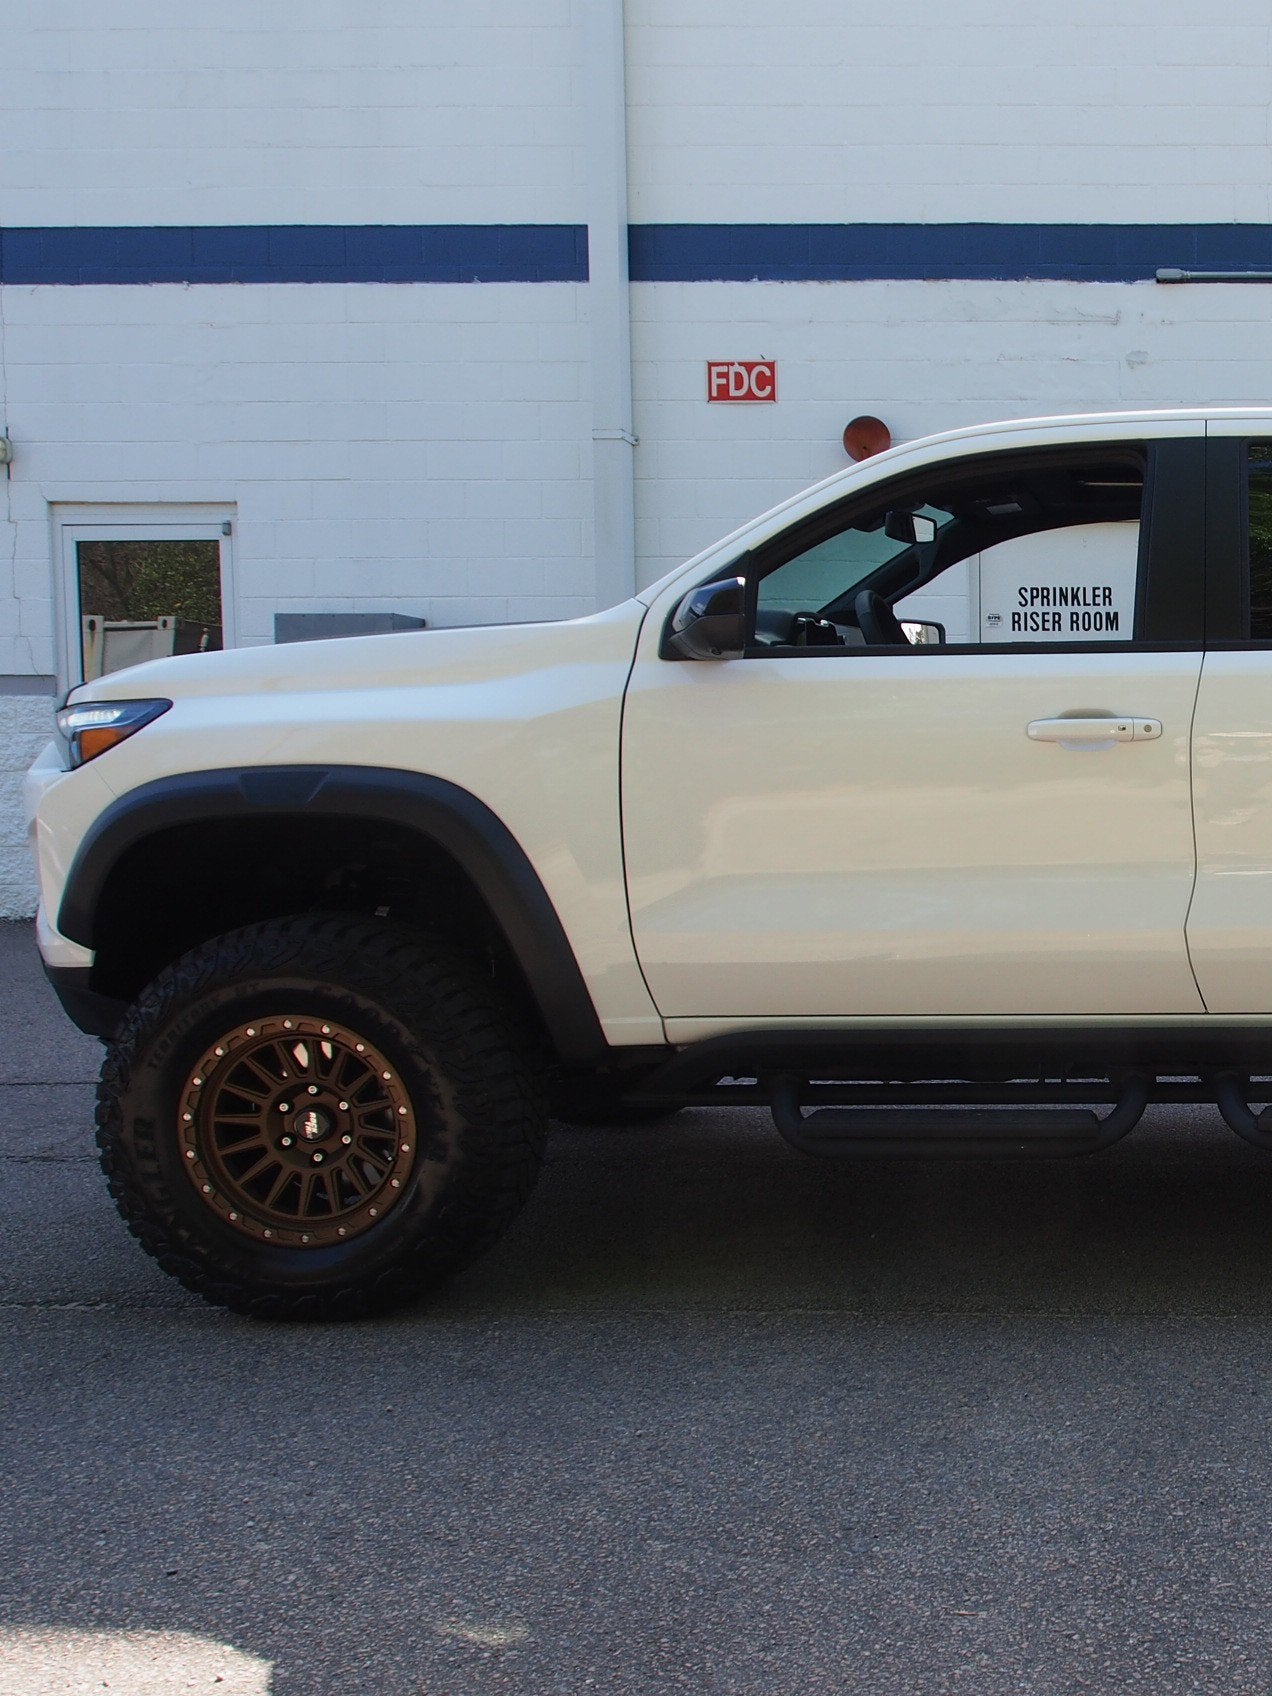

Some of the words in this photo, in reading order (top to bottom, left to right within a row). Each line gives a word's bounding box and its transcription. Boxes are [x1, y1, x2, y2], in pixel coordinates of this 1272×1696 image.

[711, 365, 772, 398] FDC
[1018, 586, 1112, 607] SPRINKLER
[1011, 611, 1063, 632] RISER
[1069, 611, 1120, 632] ROOM
